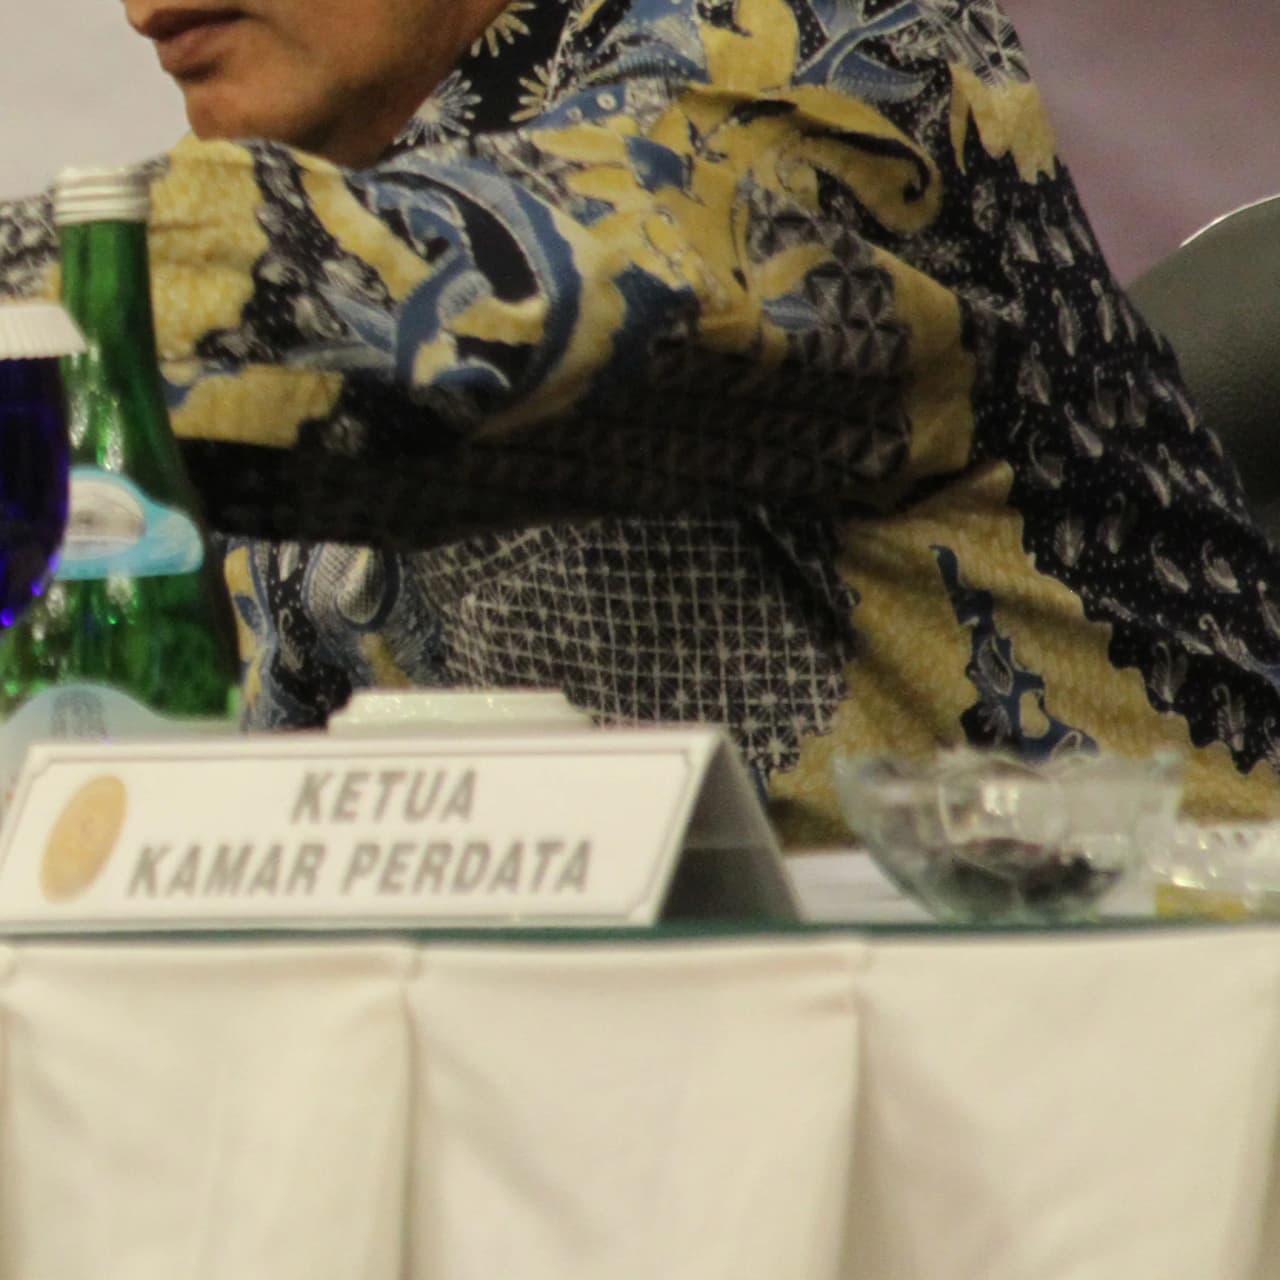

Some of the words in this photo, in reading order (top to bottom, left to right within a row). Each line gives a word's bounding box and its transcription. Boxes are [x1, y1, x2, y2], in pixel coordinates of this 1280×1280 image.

[290, 767, 477, 825] KETUA
[127, 841, 328, 898] KAMAR
[342, 838, 592, 896] PERDATA
